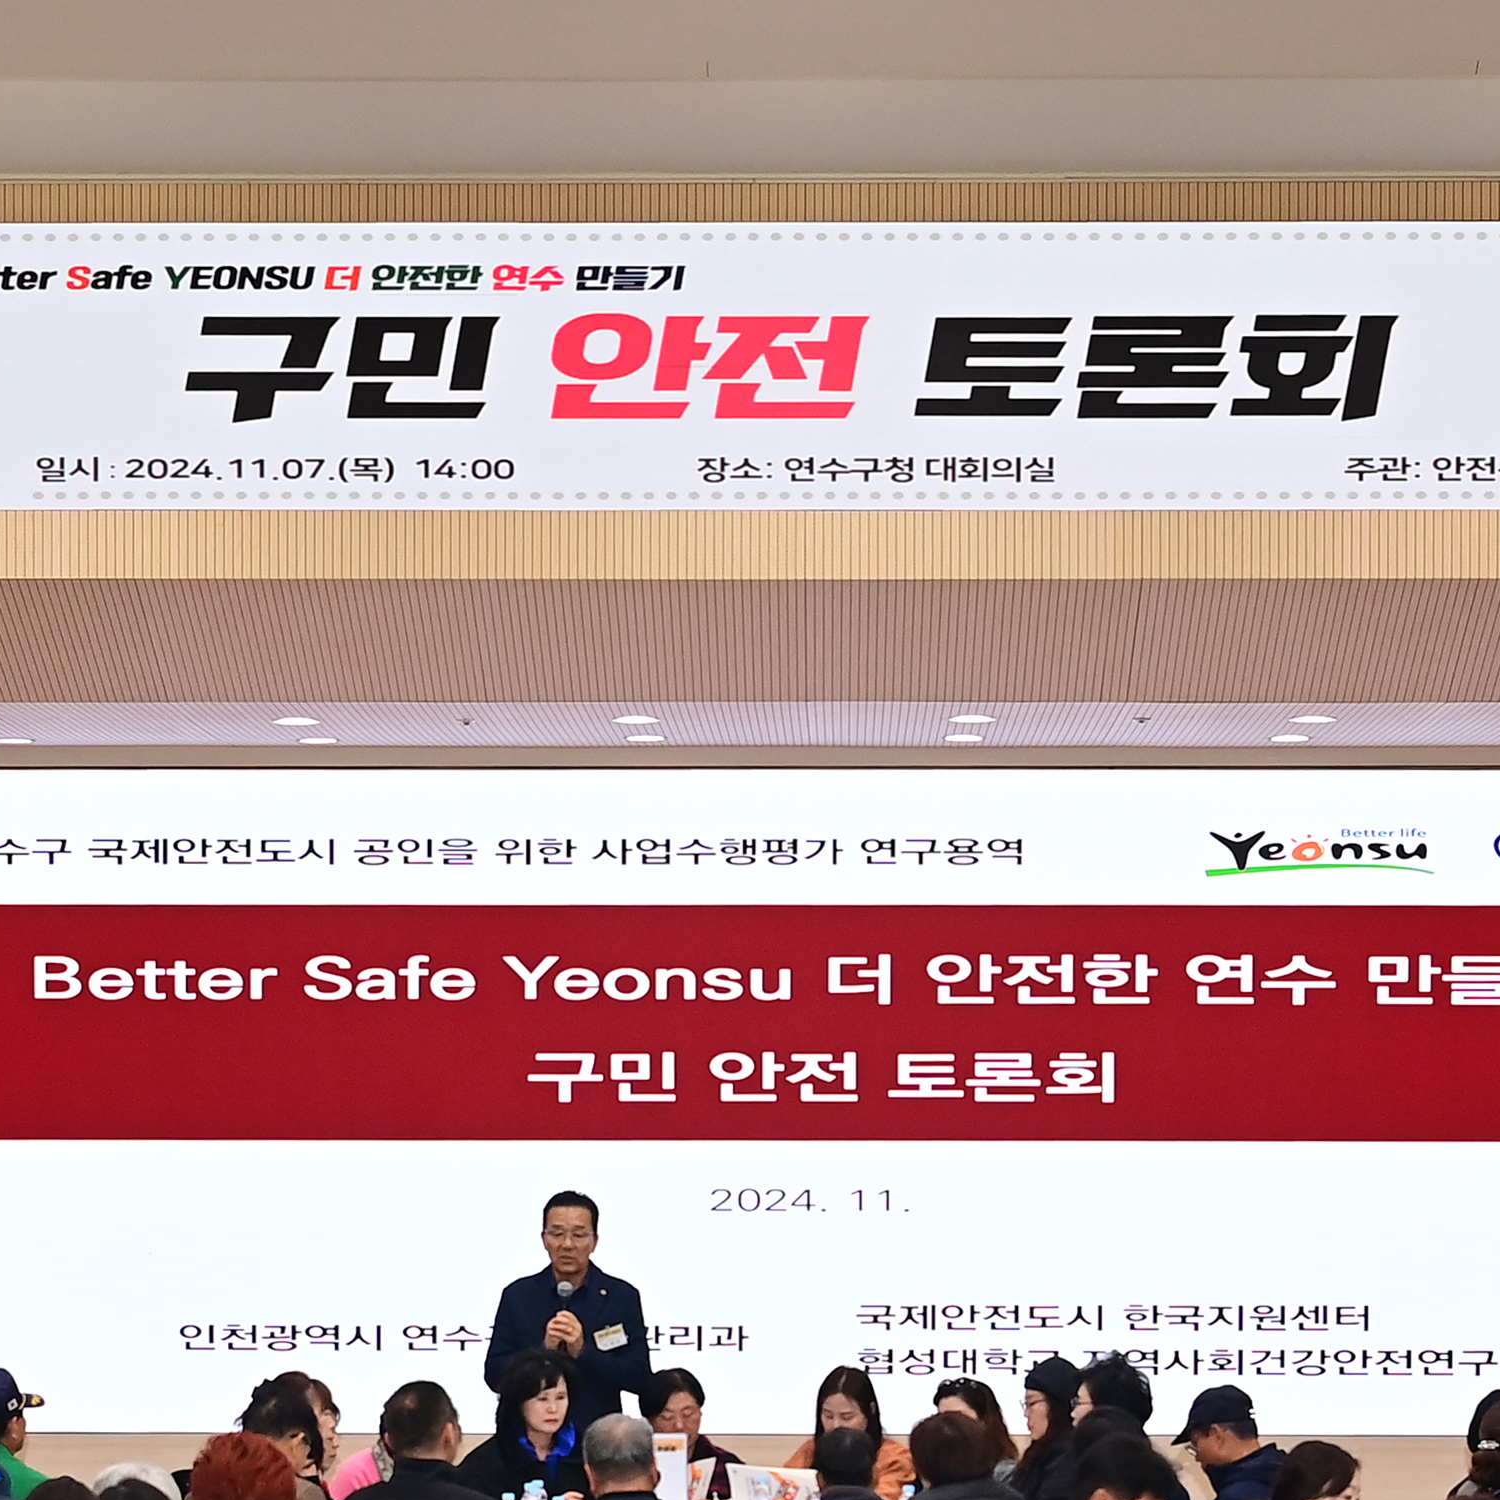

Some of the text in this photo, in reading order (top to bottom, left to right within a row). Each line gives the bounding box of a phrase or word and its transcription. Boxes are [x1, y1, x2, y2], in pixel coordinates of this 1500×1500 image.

[65, 264, 153, 291] Safe
[164, 265, 315, 291] YEONSU
[323, 265, 363, 292] 더
[371, 264, 484, 291] 안전한
[492, 264, 565, 293] 연수
[575, 265, 687, 292] 만들기
[185, 312, 1400, 424] 구민 안전 토론회
[124, 457, 395, 484] 2024.11.07.(목)
[415, 458, 515, 480] 14:00
[697, 456, 1055, 483] 장소: 연수구청 대회의실
[1343, 456, 1421, 482] 주관:
[1340, 827, 1428, 838] Better life
[87, 838, 335, 866] 국제안전도시
[353, 837, 478, 866] 공인을
[494, 838, 578, 866] 위한
[591, 838, 844, 866] 사업수행평가
[860, 837, 1023, 866] 연구용역
[1208, 829, 1428, 871] Yeonsu
[33, 955, 280, 1002] Better
[303, 955, 478, 1002] Safe
[502, 955, 793, 1002] Yeonsu
[827, 953, 893, 1006] 더
[926, 953, 1159, 1005] 안전한
[1185, 953, 1337, 1006] 연수
[526, 1051, 1117, 1104] 구민 안전 토론회
[710, 1188, 910, 1213] 2024. 11.
[855, 1304, 1370, 1332] 국제안전도시 한국지원센터
[179, 1323, 382, 1352] 인천광역시
[402, 1324, 495, 1352] 연수
